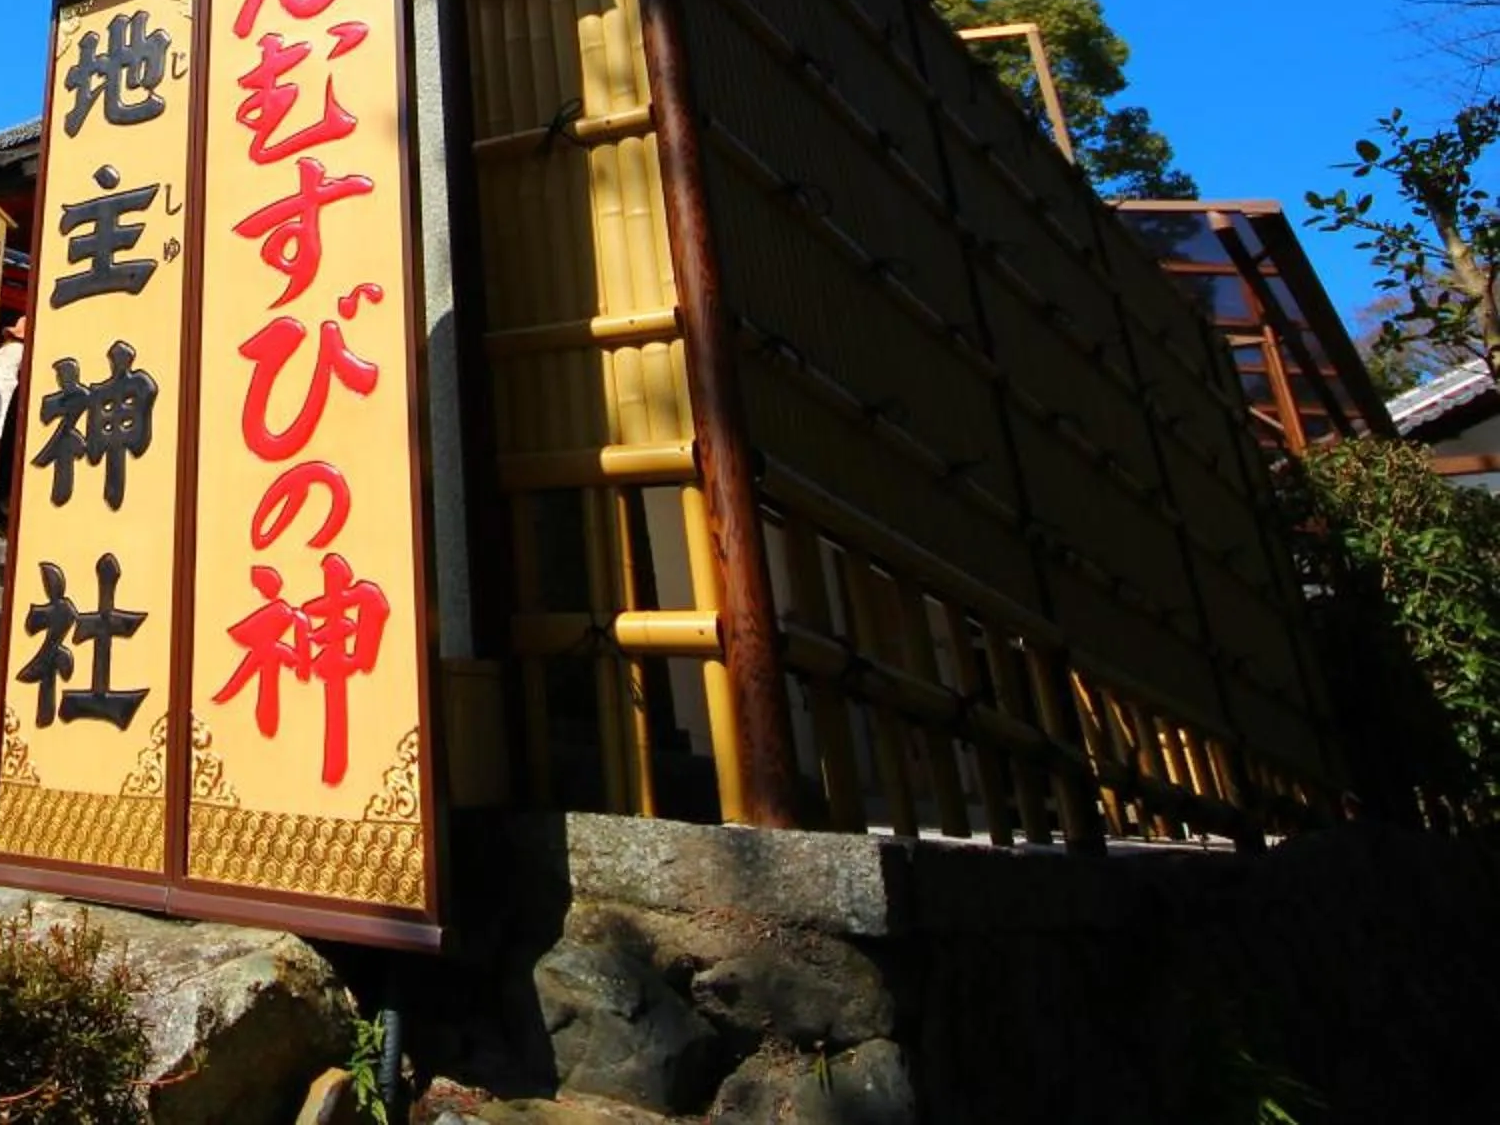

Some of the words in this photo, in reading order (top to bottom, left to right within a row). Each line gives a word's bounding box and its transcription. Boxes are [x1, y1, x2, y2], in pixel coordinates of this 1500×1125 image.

[171, 51, 189, 80] じ
[15, 9, 173, 733] 地主神社
